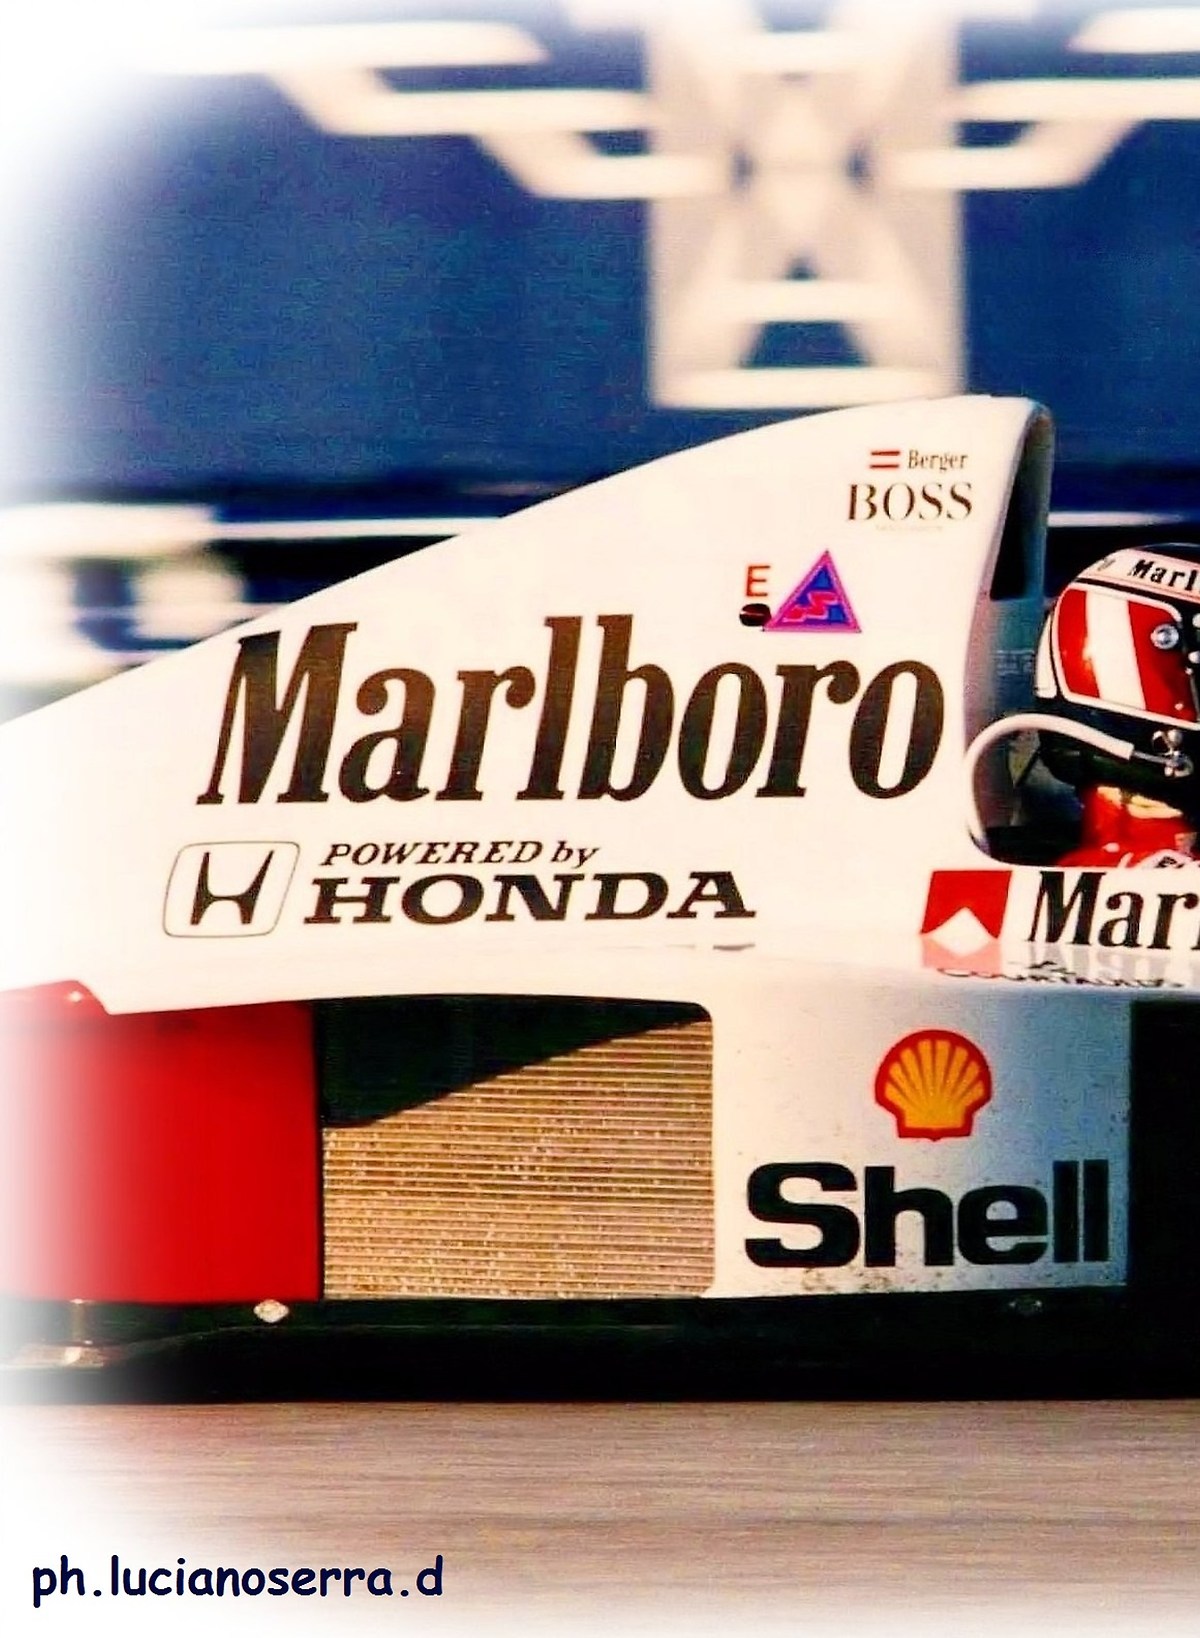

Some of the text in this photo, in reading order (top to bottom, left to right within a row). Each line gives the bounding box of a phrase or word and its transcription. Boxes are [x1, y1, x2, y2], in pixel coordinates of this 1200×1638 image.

[907, 450, 969, 471] Berger
[848, 482, 973, 522] BOSS
[196, 614, 945, 805] Marlboro
[320, 840, 600, 870] POWERED by
[303, 871, 756, 925] HONDA
[745, 1159, 1111, 1269] Shell
